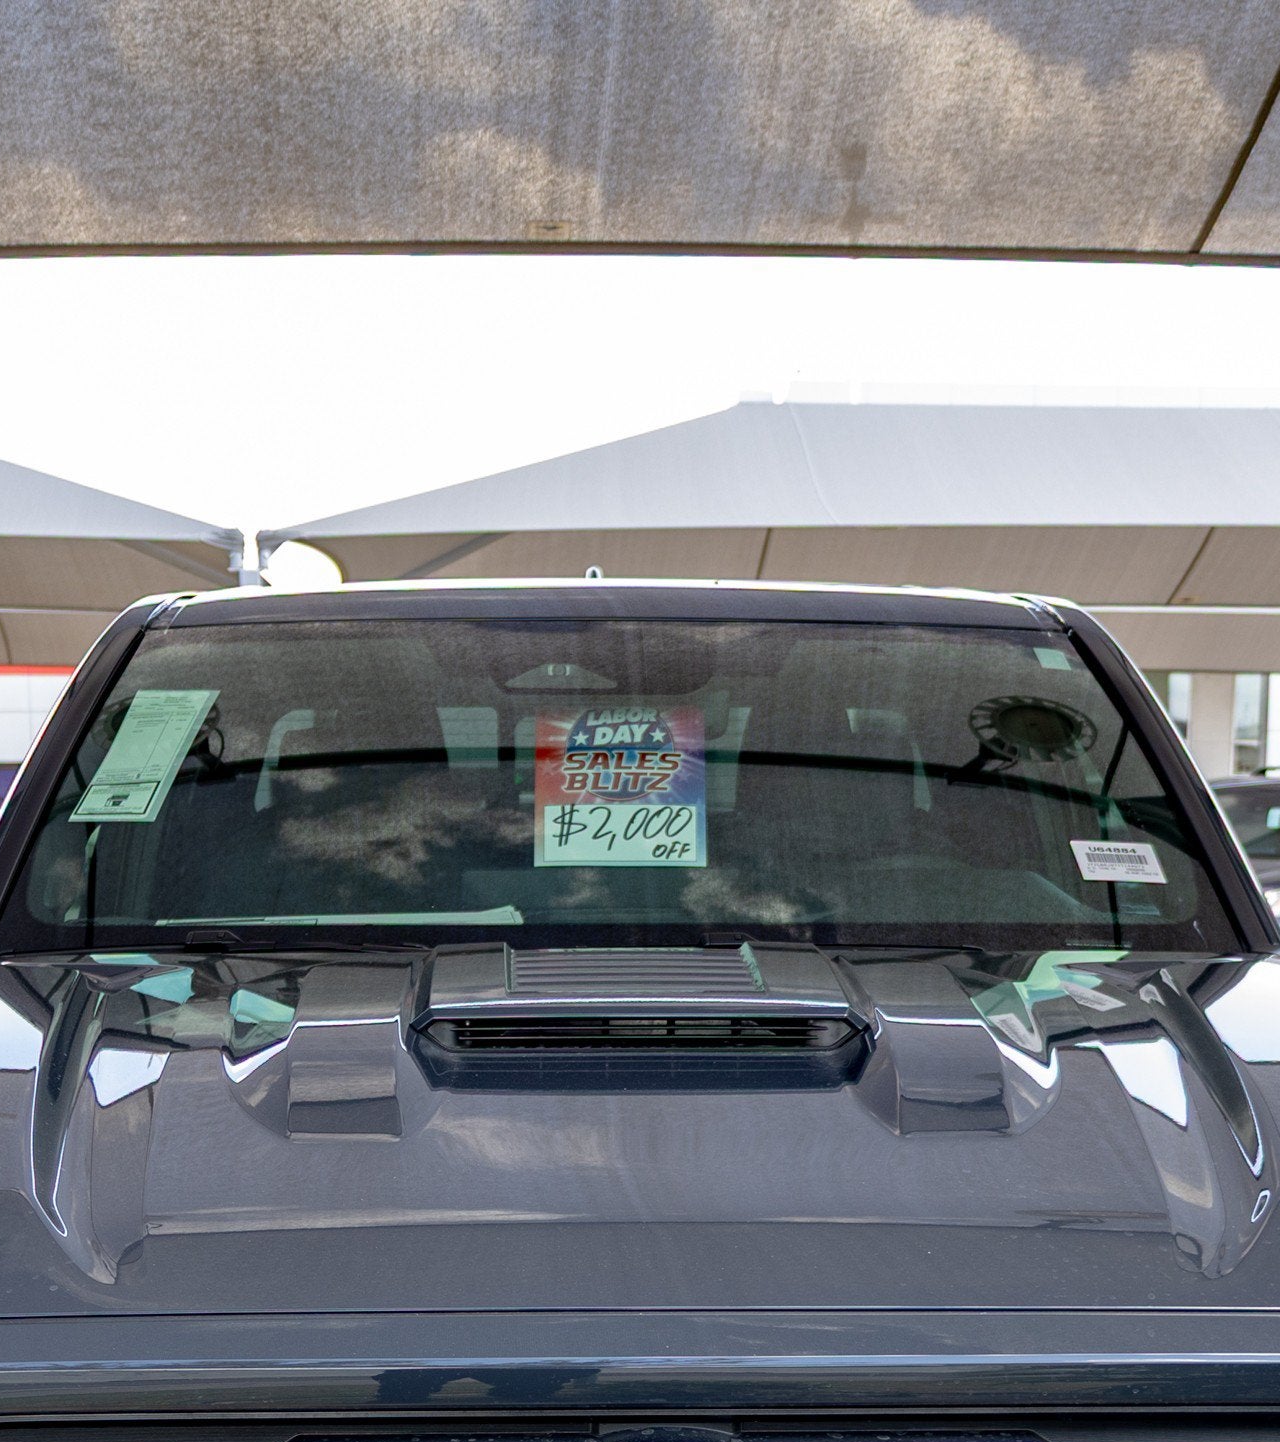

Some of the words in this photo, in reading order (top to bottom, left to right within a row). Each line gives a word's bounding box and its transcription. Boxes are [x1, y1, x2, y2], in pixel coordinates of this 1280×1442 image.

[586, 706, 658, 726] LABOR
[593, 723, 651, 746] DAY
[562, 750, 682, 772] SALES
[563, 771, 673, 792] BLITZ
[552, 803, 693, 851] $2,000
